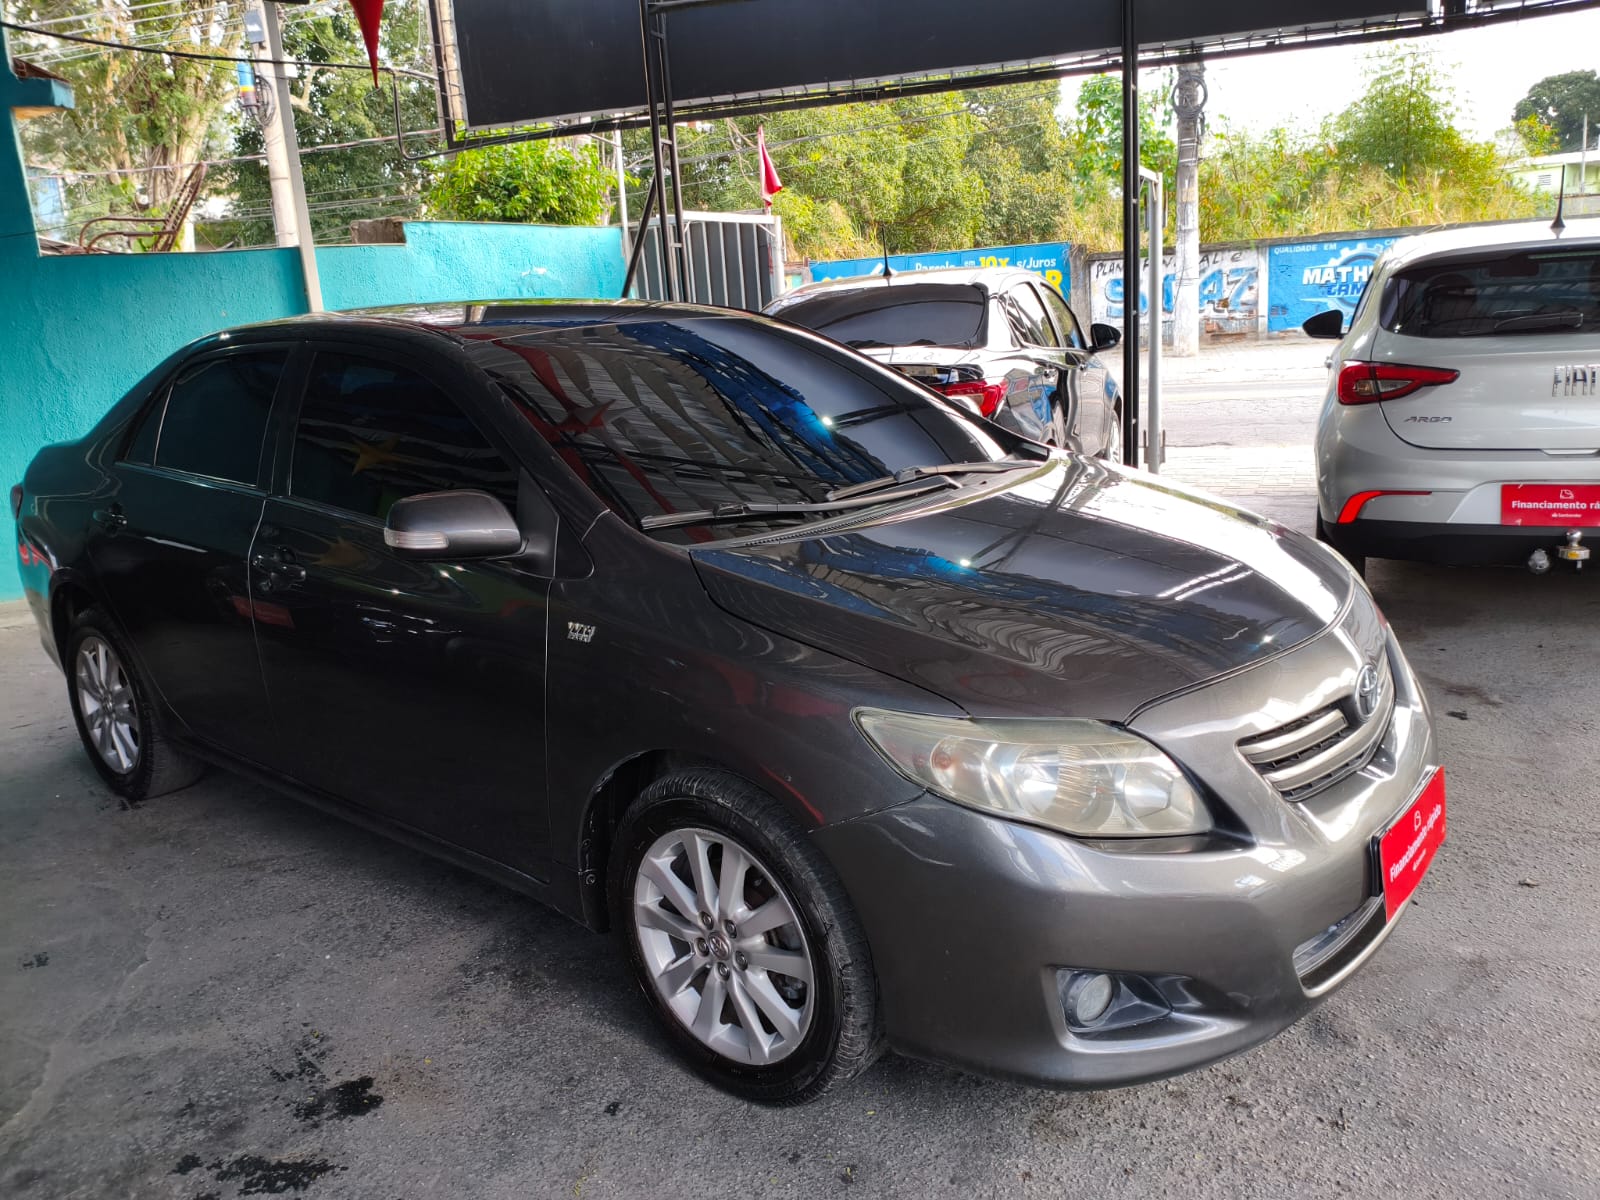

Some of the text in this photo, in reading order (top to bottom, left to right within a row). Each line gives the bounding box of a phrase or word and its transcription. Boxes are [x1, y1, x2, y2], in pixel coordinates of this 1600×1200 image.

[1273, 244, 1318, 255] QUALIDADE
[1323, 242, 1337, 250] EM
[1016, 257, 1057, 271] s/Juros
[1403, 415, 1453, 424] ARGO
[1511, 500, 1587, 510] Financiamento
[1390, 826, 1427, 883] Financiamento
